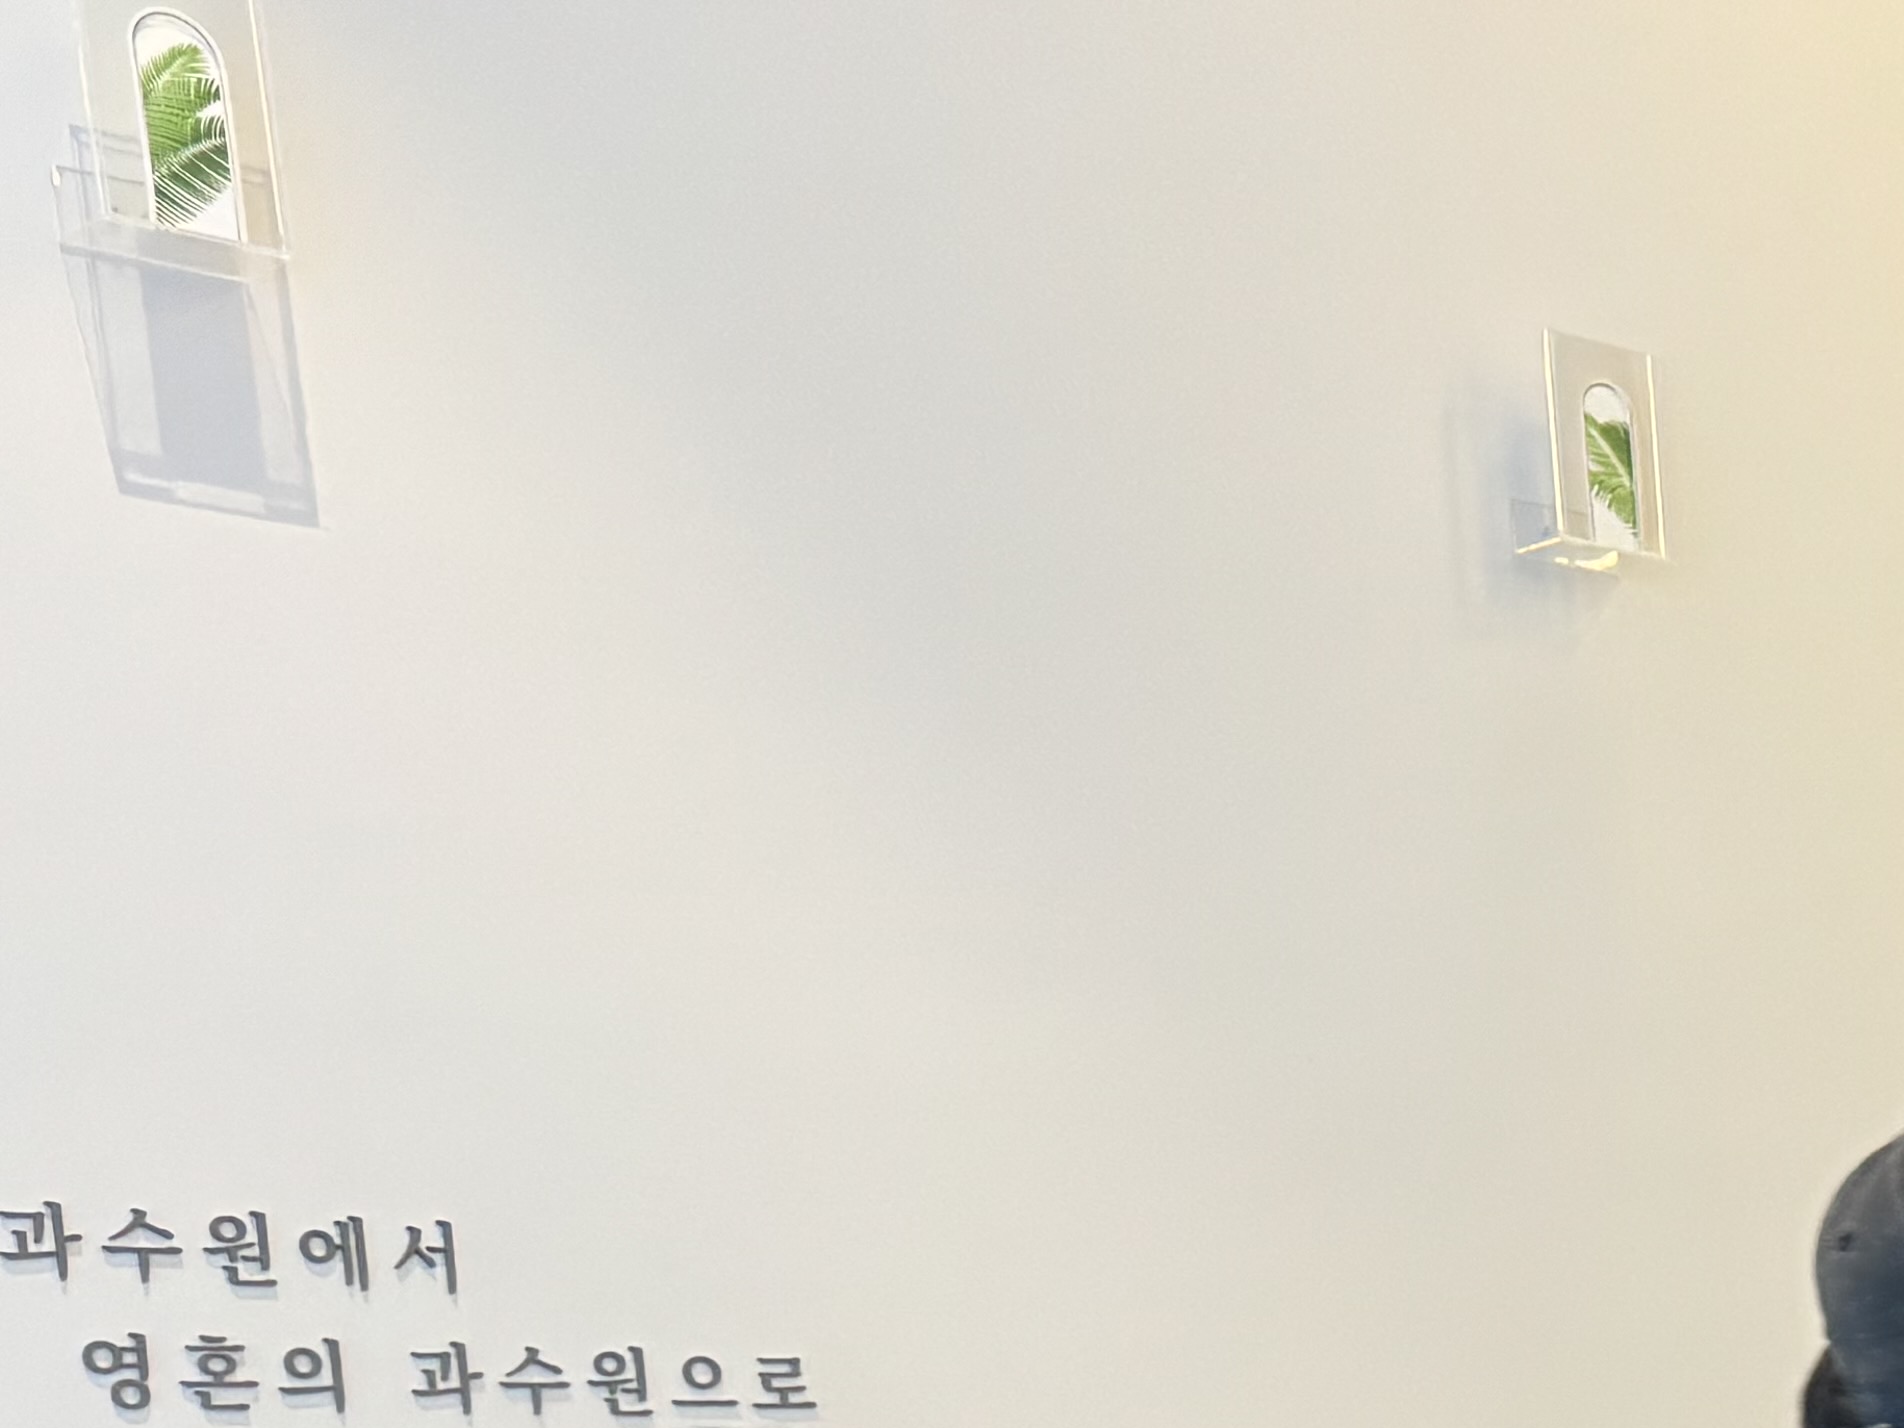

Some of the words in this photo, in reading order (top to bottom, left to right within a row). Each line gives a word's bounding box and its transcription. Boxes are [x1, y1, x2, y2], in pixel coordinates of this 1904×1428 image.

[0, 1200, 458, 1296] 과수원에서
[82, 1332, 345, 1414] 영혼의
[410, 1341, 817, 1416] 과수원으로
